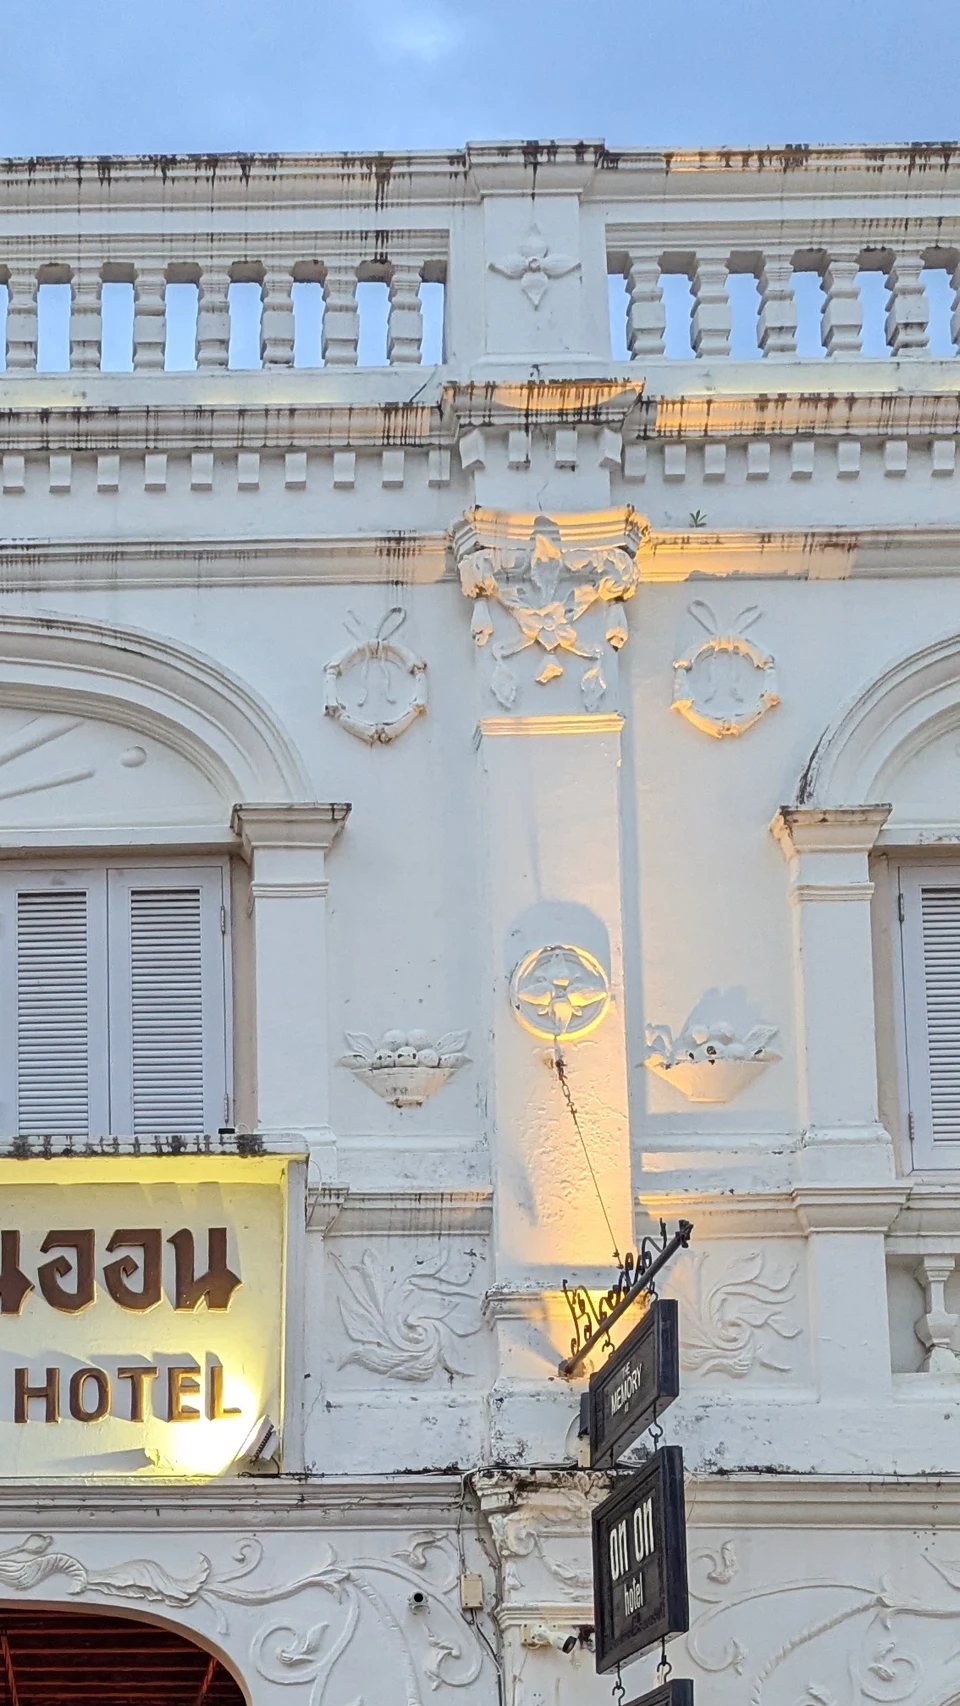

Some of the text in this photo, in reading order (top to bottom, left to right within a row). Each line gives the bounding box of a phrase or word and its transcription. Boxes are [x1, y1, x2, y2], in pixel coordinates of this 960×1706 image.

[14, 1364, 243, 1424] HOTEL
[610, 1363, 643, 1416] MEMORY
[609, 1497, 655, 1581] on on
[624, 1572, 644, 1617] hotel
